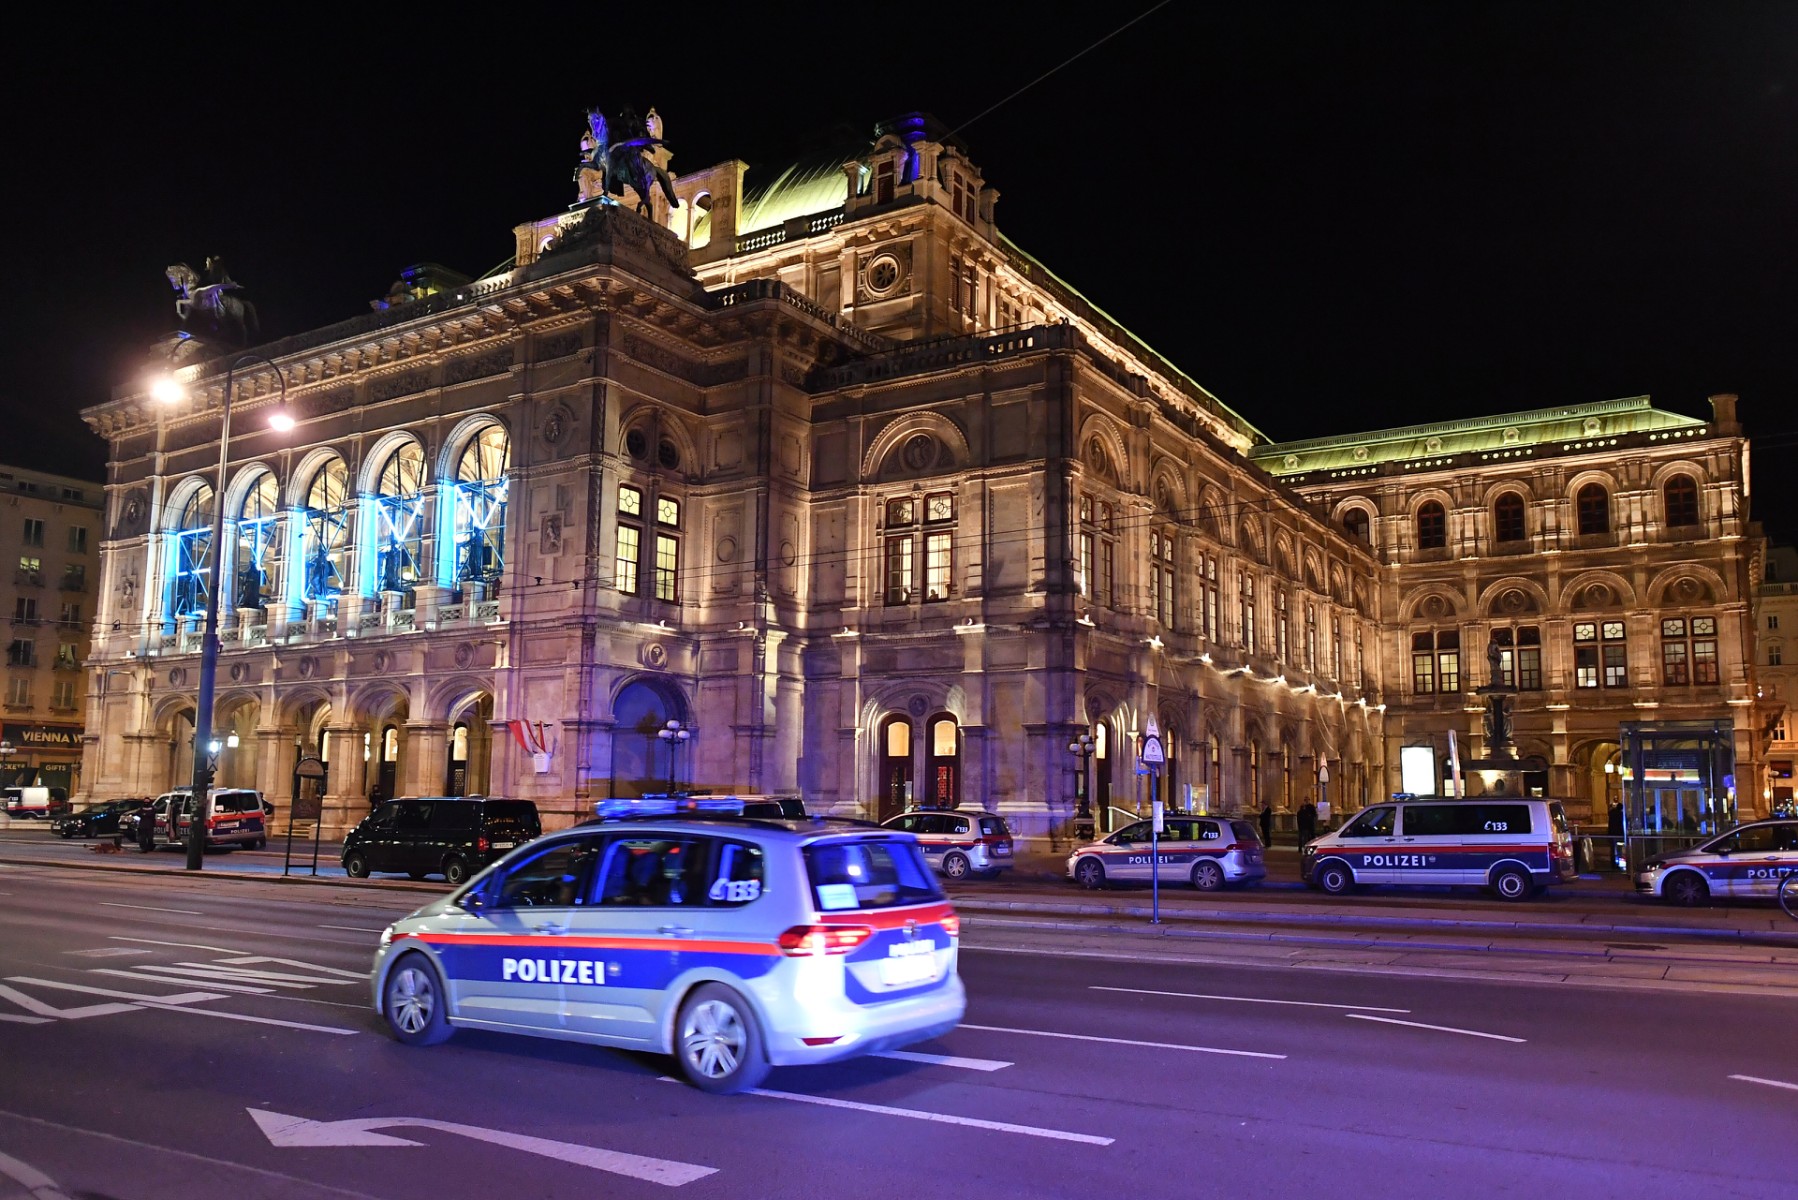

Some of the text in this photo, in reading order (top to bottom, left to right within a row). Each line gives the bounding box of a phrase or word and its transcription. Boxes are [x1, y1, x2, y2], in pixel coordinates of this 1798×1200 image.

[22, 731, 70, 743] VIENNA
[1491, 822, 1508, 831] 133
[1128, 856, 1168, 864] POLIEI
[1363, 855, 1427, 867] POLIZEI
[502, 958, 605, 985] POLIZEI
